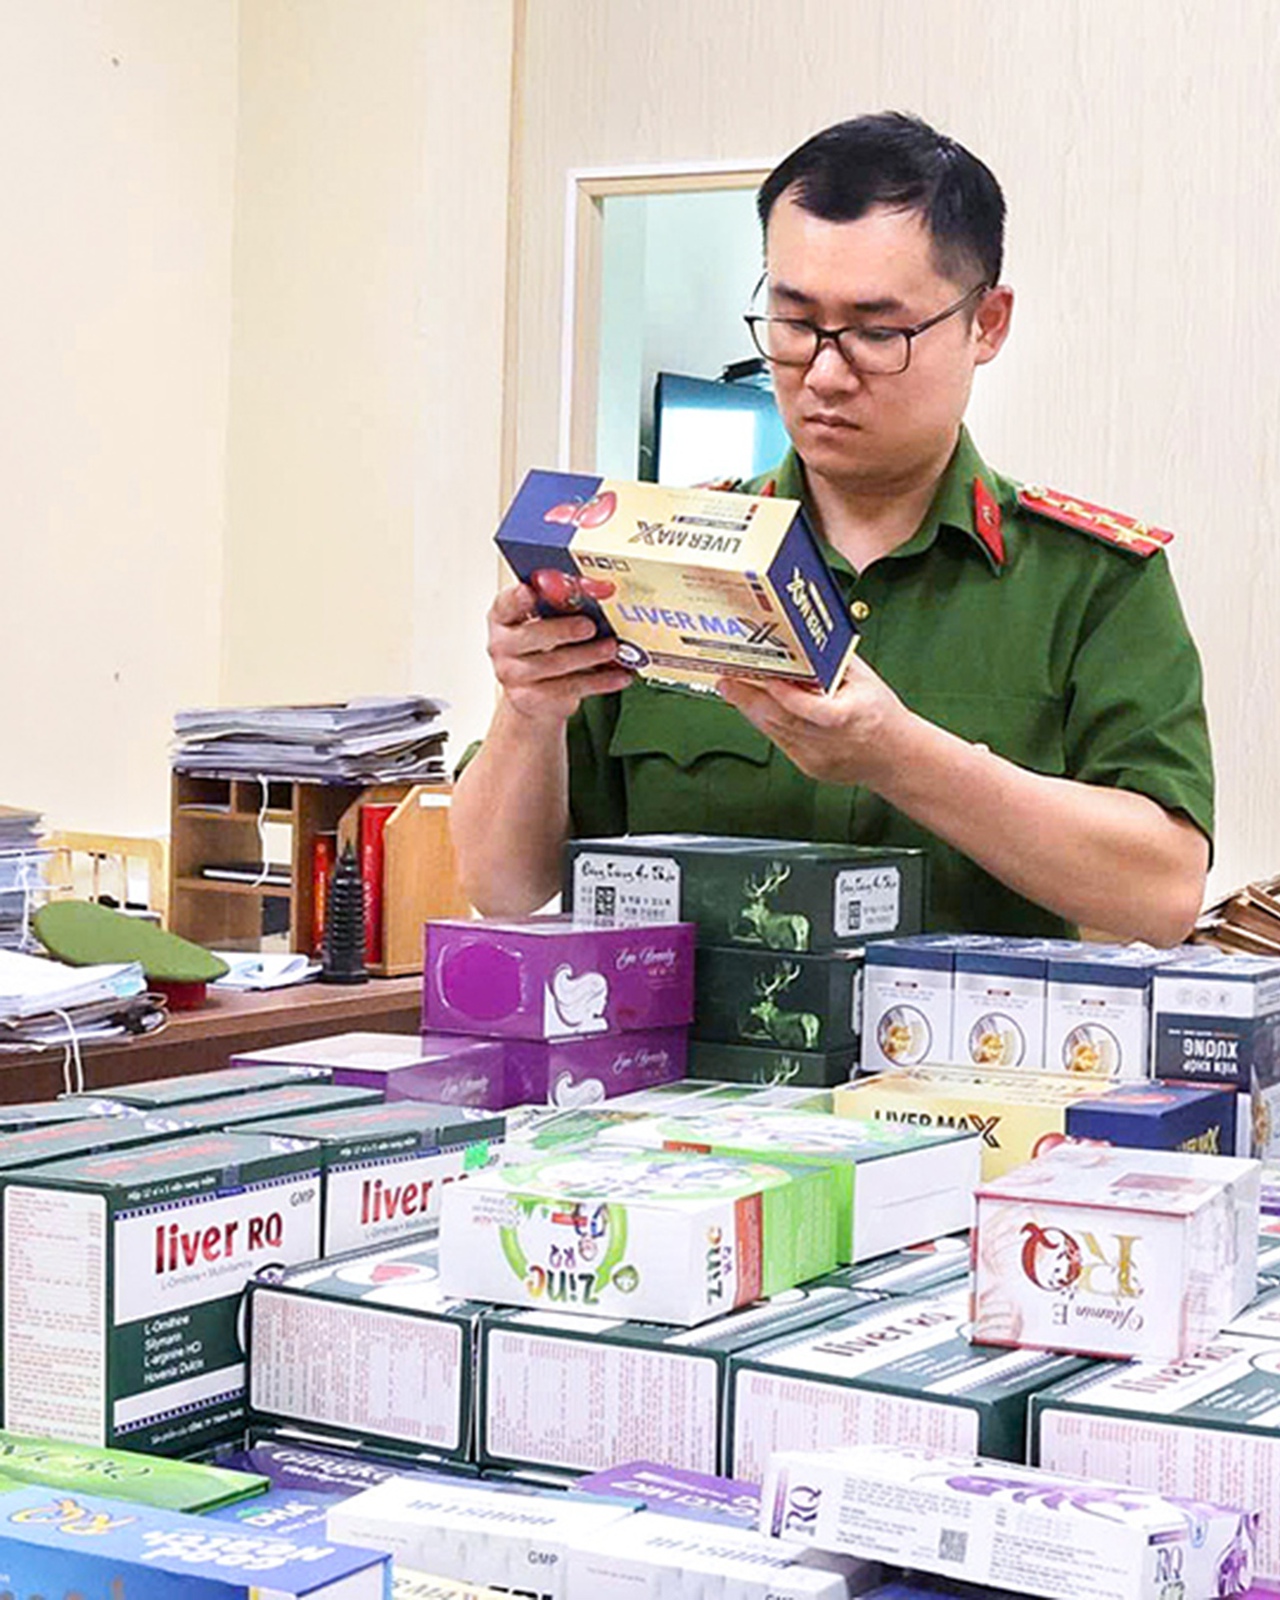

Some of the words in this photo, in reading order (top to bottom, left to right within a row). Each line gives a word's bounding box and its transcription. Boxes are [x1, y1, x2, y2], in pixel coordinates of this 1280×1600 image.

[688, 533, 742, 554] LIVER
[616, 602, 698, 632] LIVER
[699, 613, 790, 649] MAX
[1182, 1037, 1239, 1060] XƯƠNG
[360, 1178, 434, 1226] liver
[155, 1221, 239, 1276] liver
[247, 1211, 284, 1252] RQ
[548, 1243, 577, 1270] RQ
[1051, 1302, 1069, 1326] E
[811, 1325, 914, 1358] liver
[785, 1485, 822, 1537] RQ
[527, 1550, 559, 1564] GMP
[1154, 1545, 1183, 1584] RQ
